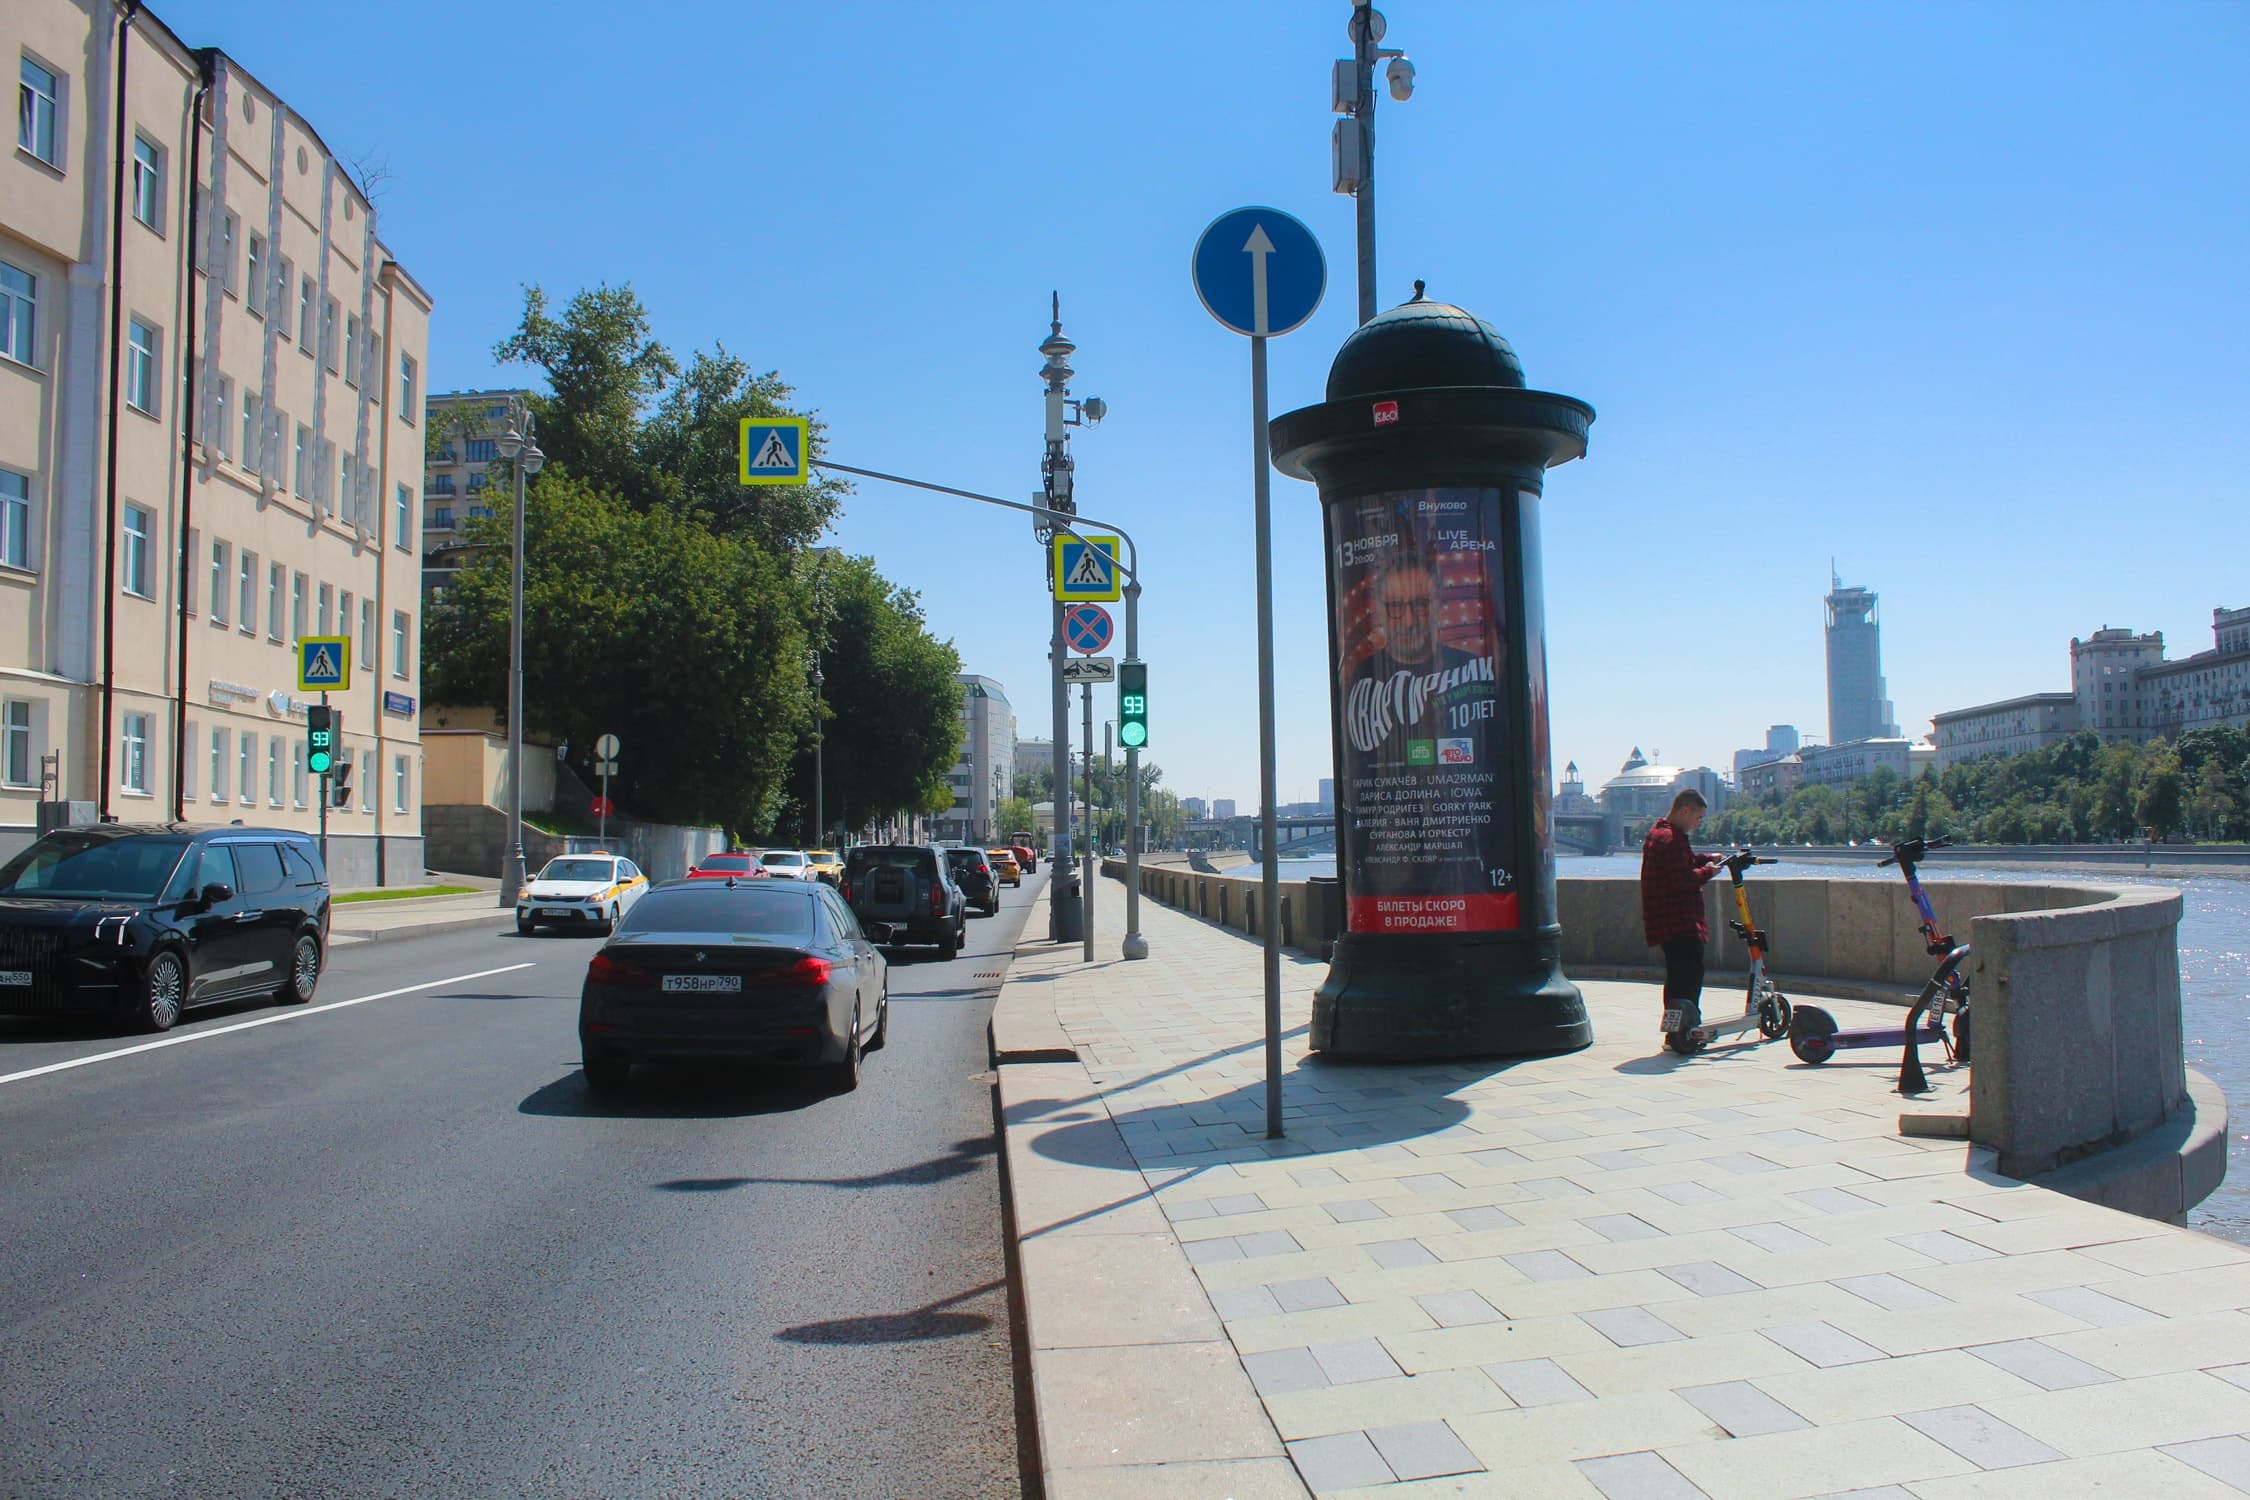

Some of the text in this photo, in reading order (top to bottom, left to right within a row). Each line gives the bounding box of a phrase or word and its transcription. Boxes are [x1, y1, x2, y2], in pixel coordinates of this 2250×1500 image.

[1418, 501, 1467, 512] Внуково
[1438, 530, 1468, 540] LIVE
[1335, 533, 1399, 569] 13 НОЯБРЯ
[1450, 540, 1495, 551] АРЕНА
[1124, 696, 1144, 714] 93
[1347, 656, 1495, 751] КВАРТИРНИК
[1449, 699, 1496, 730] 10 ЛЕТ
[312, 731, 329, 746] 93
[1427, 773, 1494, 785] UMA2RMAN
[1360, 790, 1441, 801] ЛАРИСА ДОЛИНА
[1450, 787, 1482, 798] IOWA
[1377, 804, 1424, 815] РОДРИГЕЗ
[1432, 801, 1492, 813] GORKY PARK
[1395, 815, 1491, 827] ВАНЯ ДМИТРИЕНКО
[1369, 828, 1471, 840] СУРГАНОВА И ОРКЕСТР
[1375, 841, 1463, 852] АЛЕКСАНДР МАРШАЛ
[1411, 855, 1437, 863] СКЛЯР
[1489, 868, 1513, 887] 12+
[1377, 899, 1466, 912] БИЛЕТЫ СКОРО
[1385, 915, 1457, 928] В ПРОДАЖЕ!
